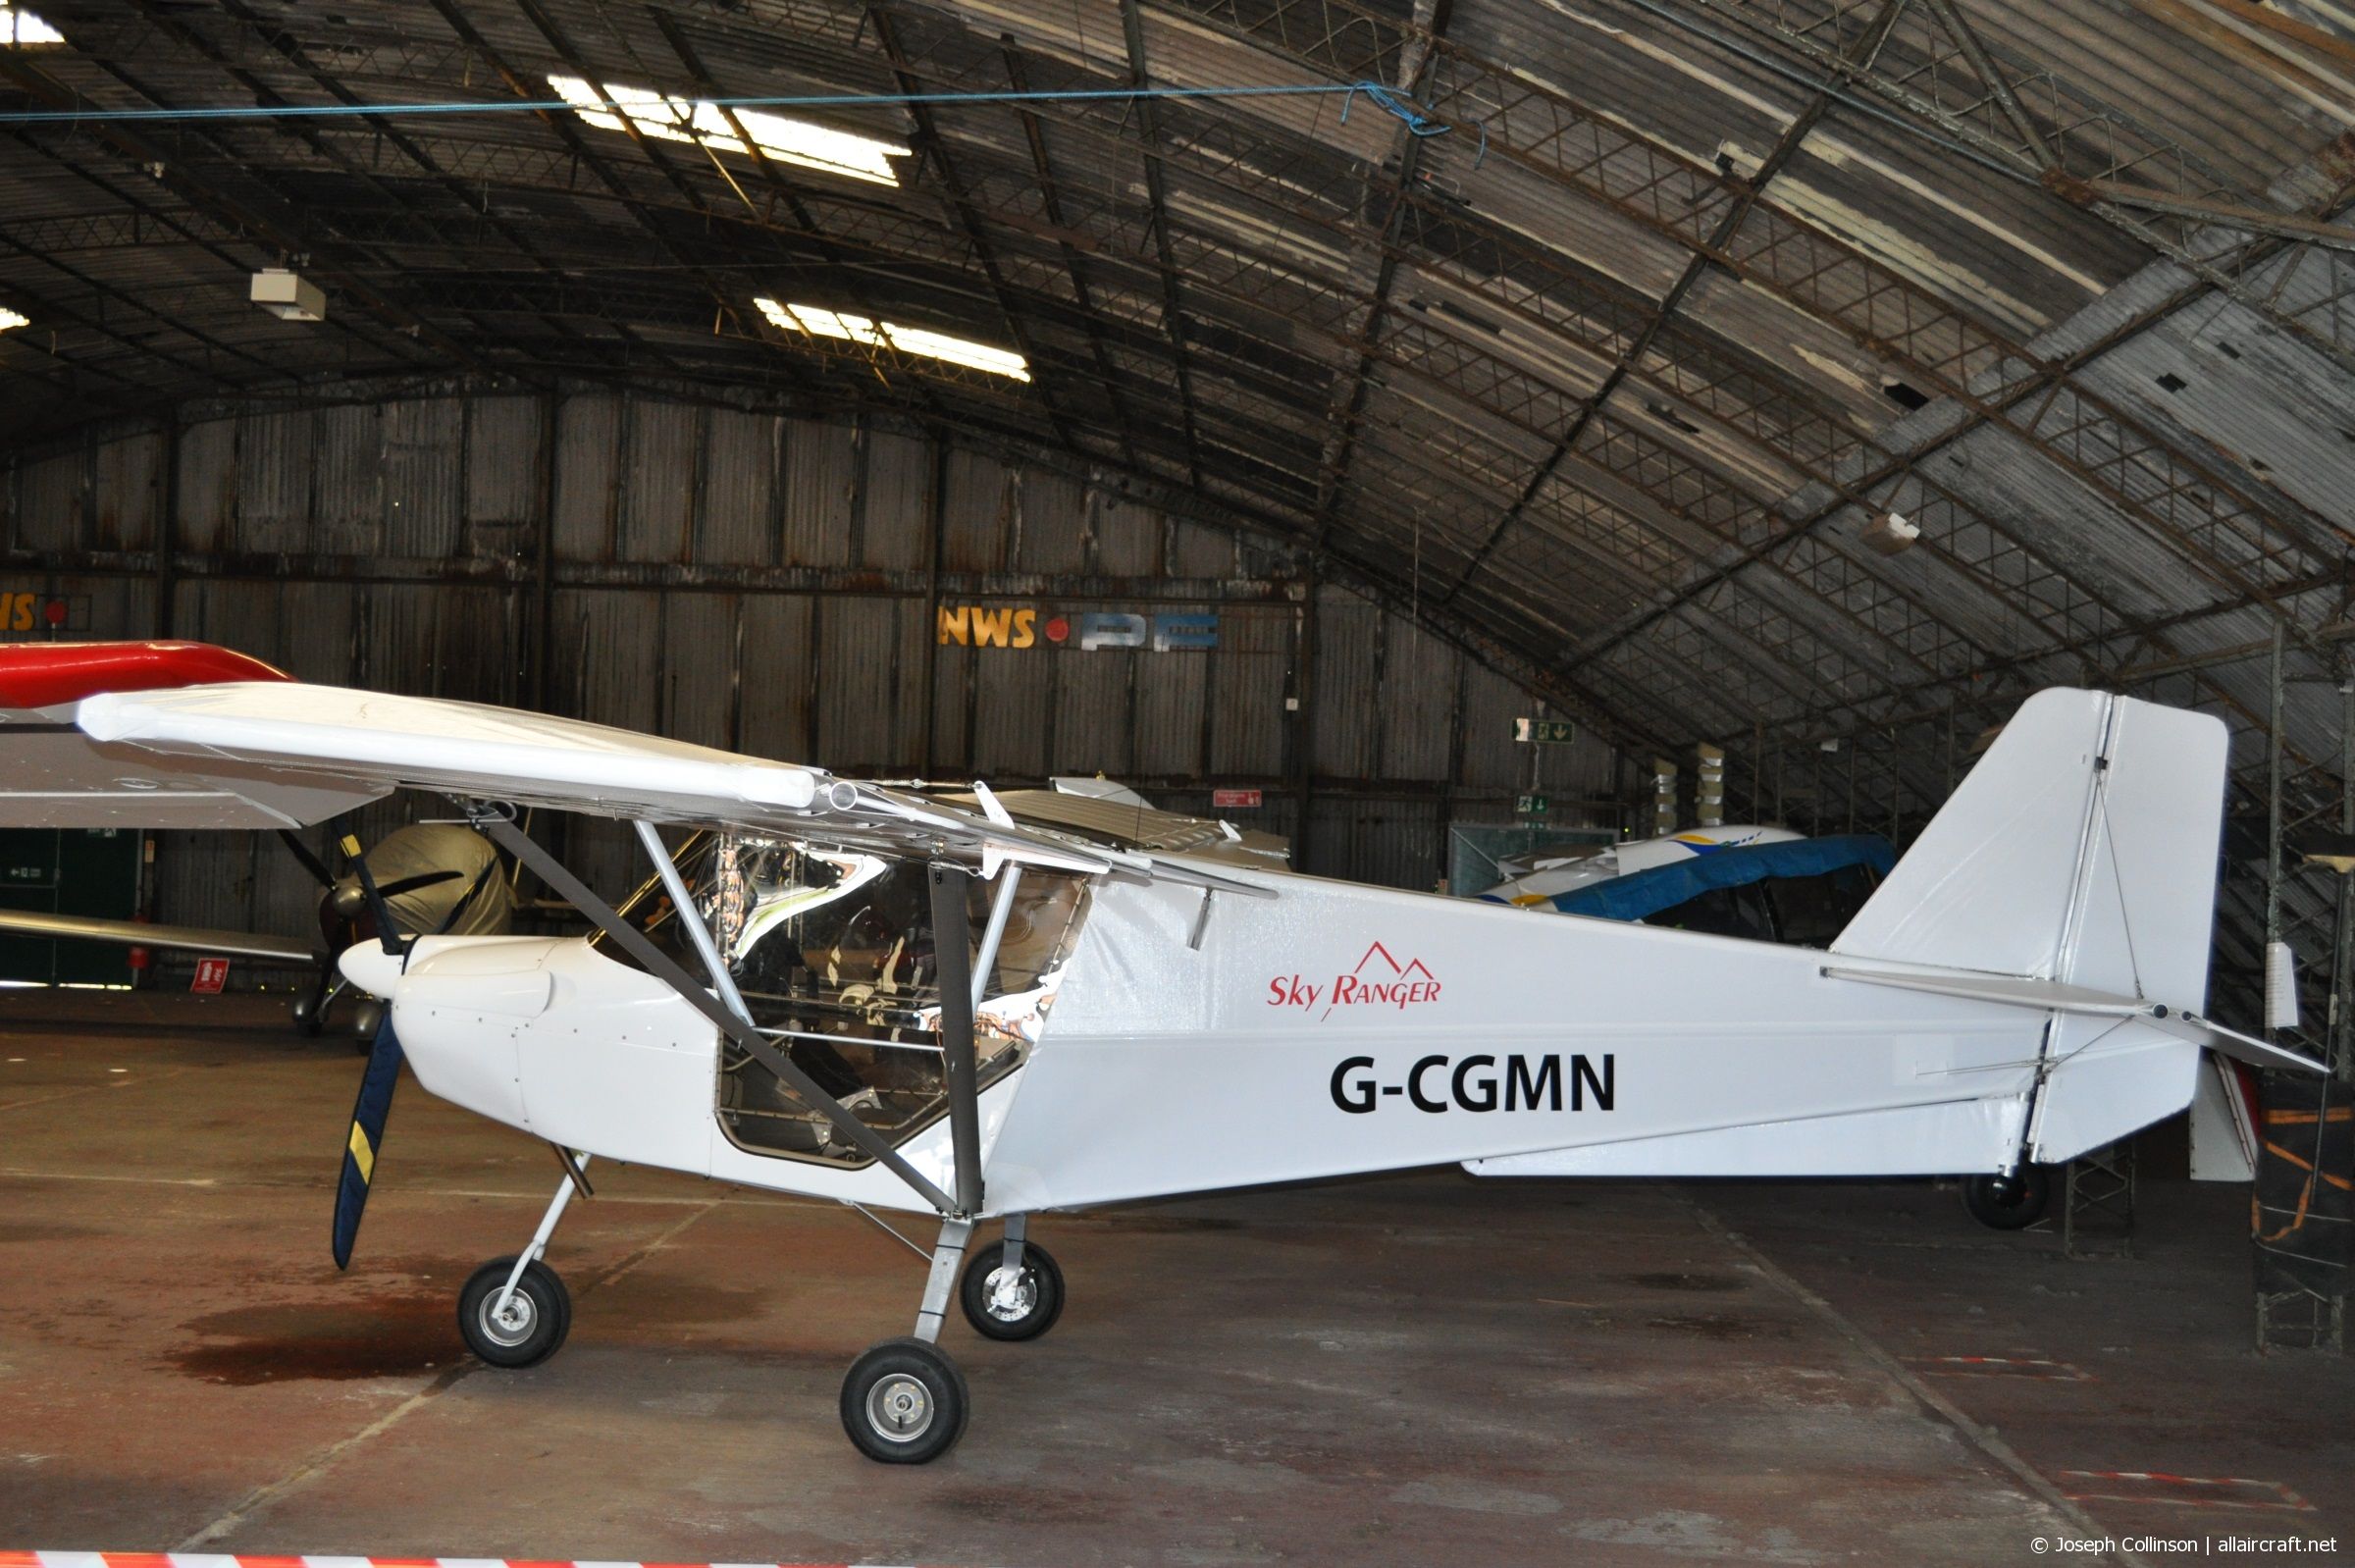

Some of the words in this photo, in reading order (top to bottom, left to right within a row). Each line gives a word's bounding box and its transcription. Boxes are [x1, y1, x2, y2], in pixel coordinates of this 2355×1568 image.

[937, 605, 1036, 649] NWS
[1267, 974, 1324, 1012] Sky
[1331, 1054, 1615, 1114] G-CGMN
